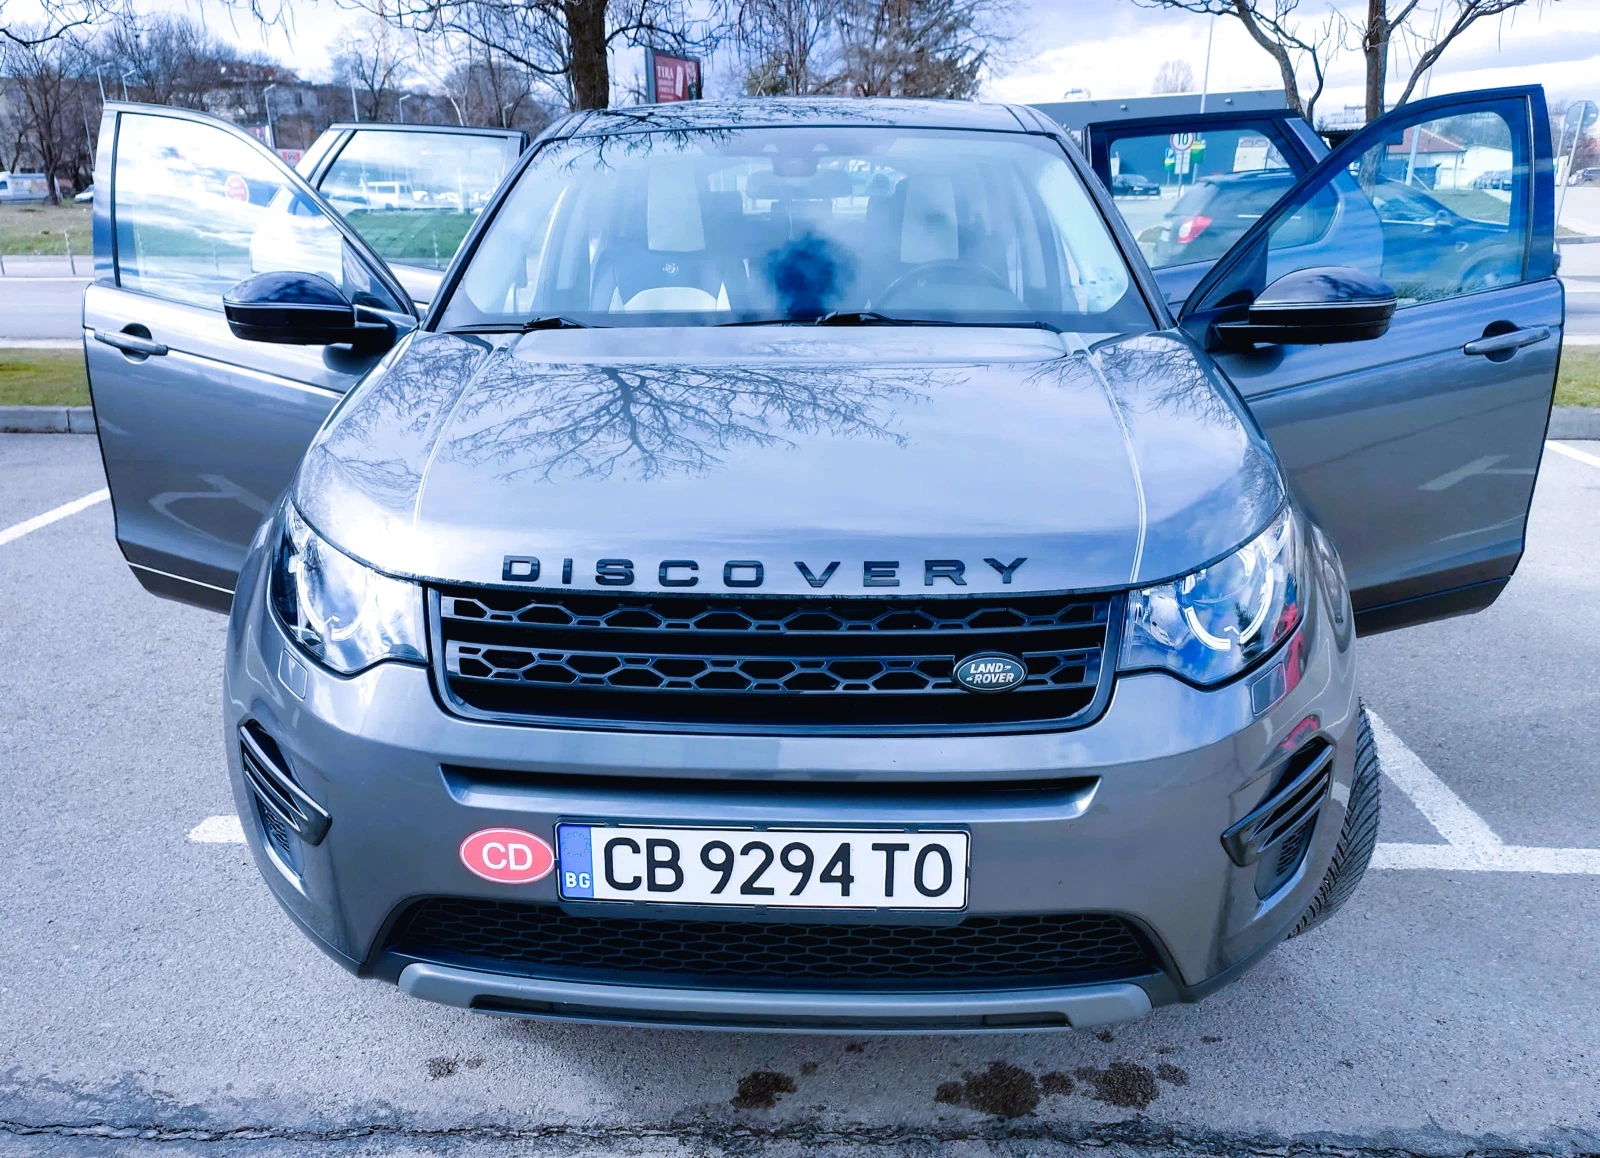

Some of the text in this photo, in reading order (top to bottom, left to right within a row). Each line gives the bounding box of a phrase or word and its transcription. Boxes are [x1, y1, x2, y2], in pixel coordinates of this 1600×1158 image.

[1177, 132, 1189, 145] 10
[1168, 149, 1174, 158] P
[501, 555, 1027, 588] DISCOVERY
[970, 663, 1003, 673] LAND
[974, 673, 1014, 684] ROVER
[482, 841, 533, 872] CD
[604, 837, 952, 898] CB 9294 TO
[565, 871, 591, 890] BG
